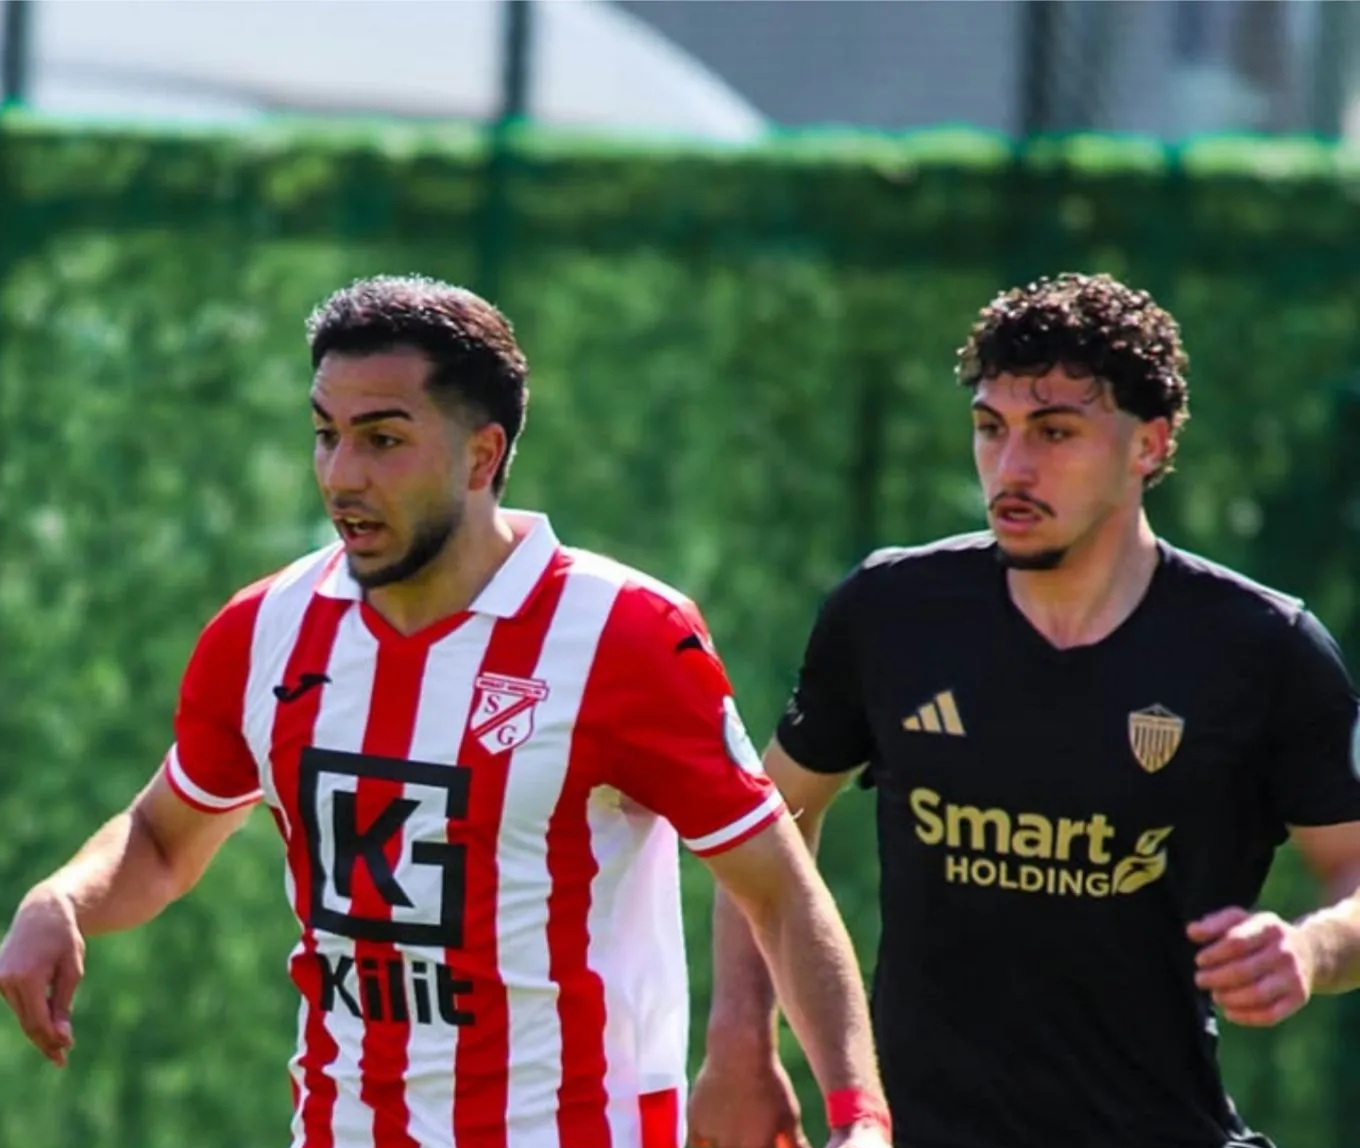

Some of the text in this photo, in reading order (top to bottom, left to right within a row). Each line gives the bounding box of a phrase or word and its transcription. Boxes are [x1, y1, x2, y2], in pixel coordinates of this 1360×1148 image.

[909, 787, 1115, 865] Smart
[944, 855, 1112, 897] HOLDING
[314, 953, 476, 1028] Kilit
